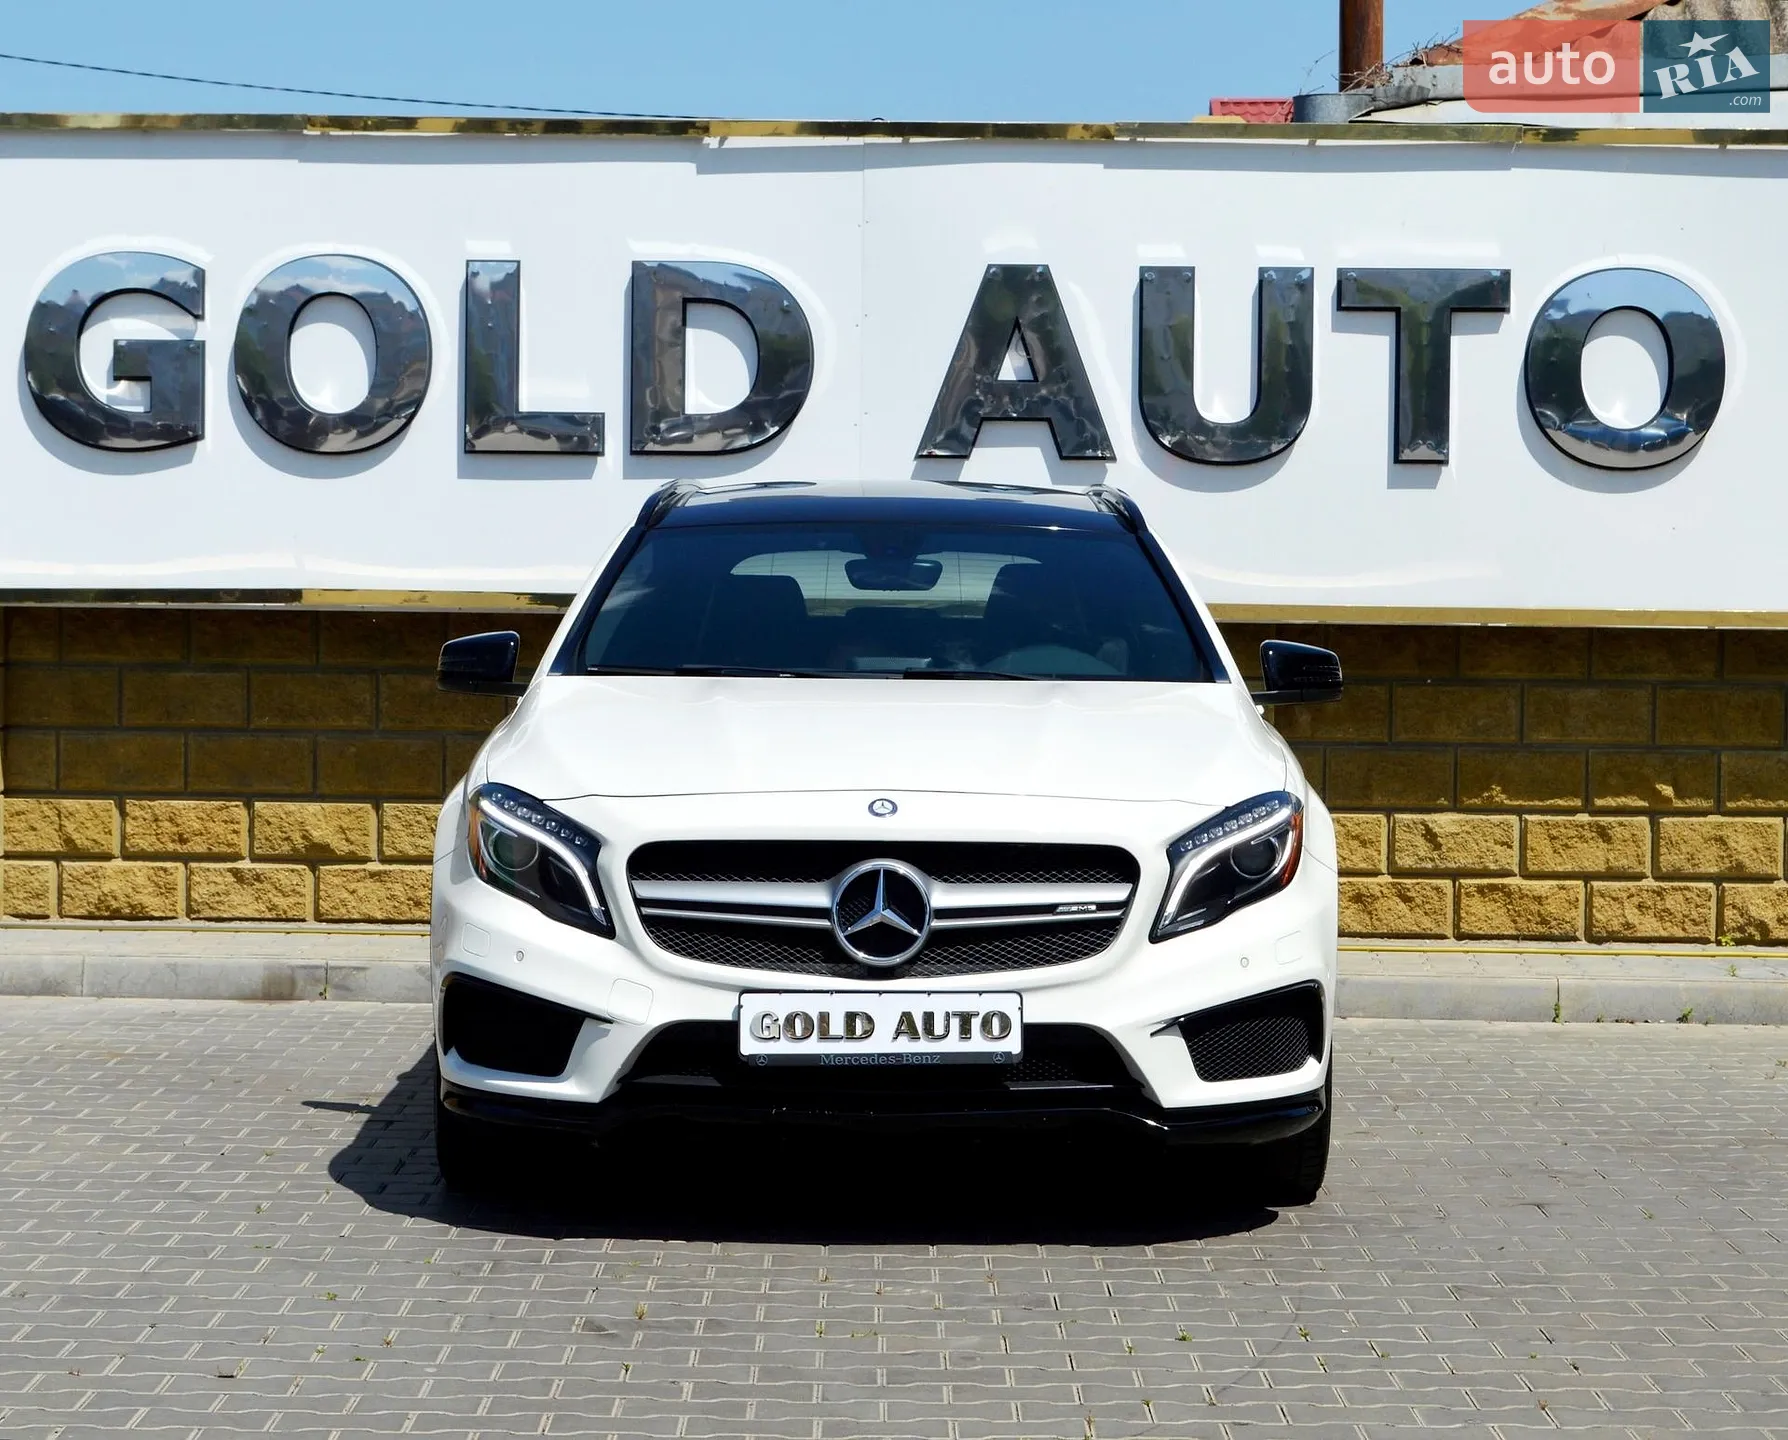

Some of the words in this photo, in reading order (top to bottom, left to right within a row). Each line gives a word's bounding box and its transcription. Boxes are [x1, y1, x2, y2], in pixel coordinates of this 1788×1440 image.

[24, 251, 815, 456] GOLD
[914, 263, 1727, 470] AUTO
[750, 1010, 875, 1042] GOLD
[891, 1010, 1012, 1041] AUTO
[819, 1053, 941, 1066] Mercedes-Benz
